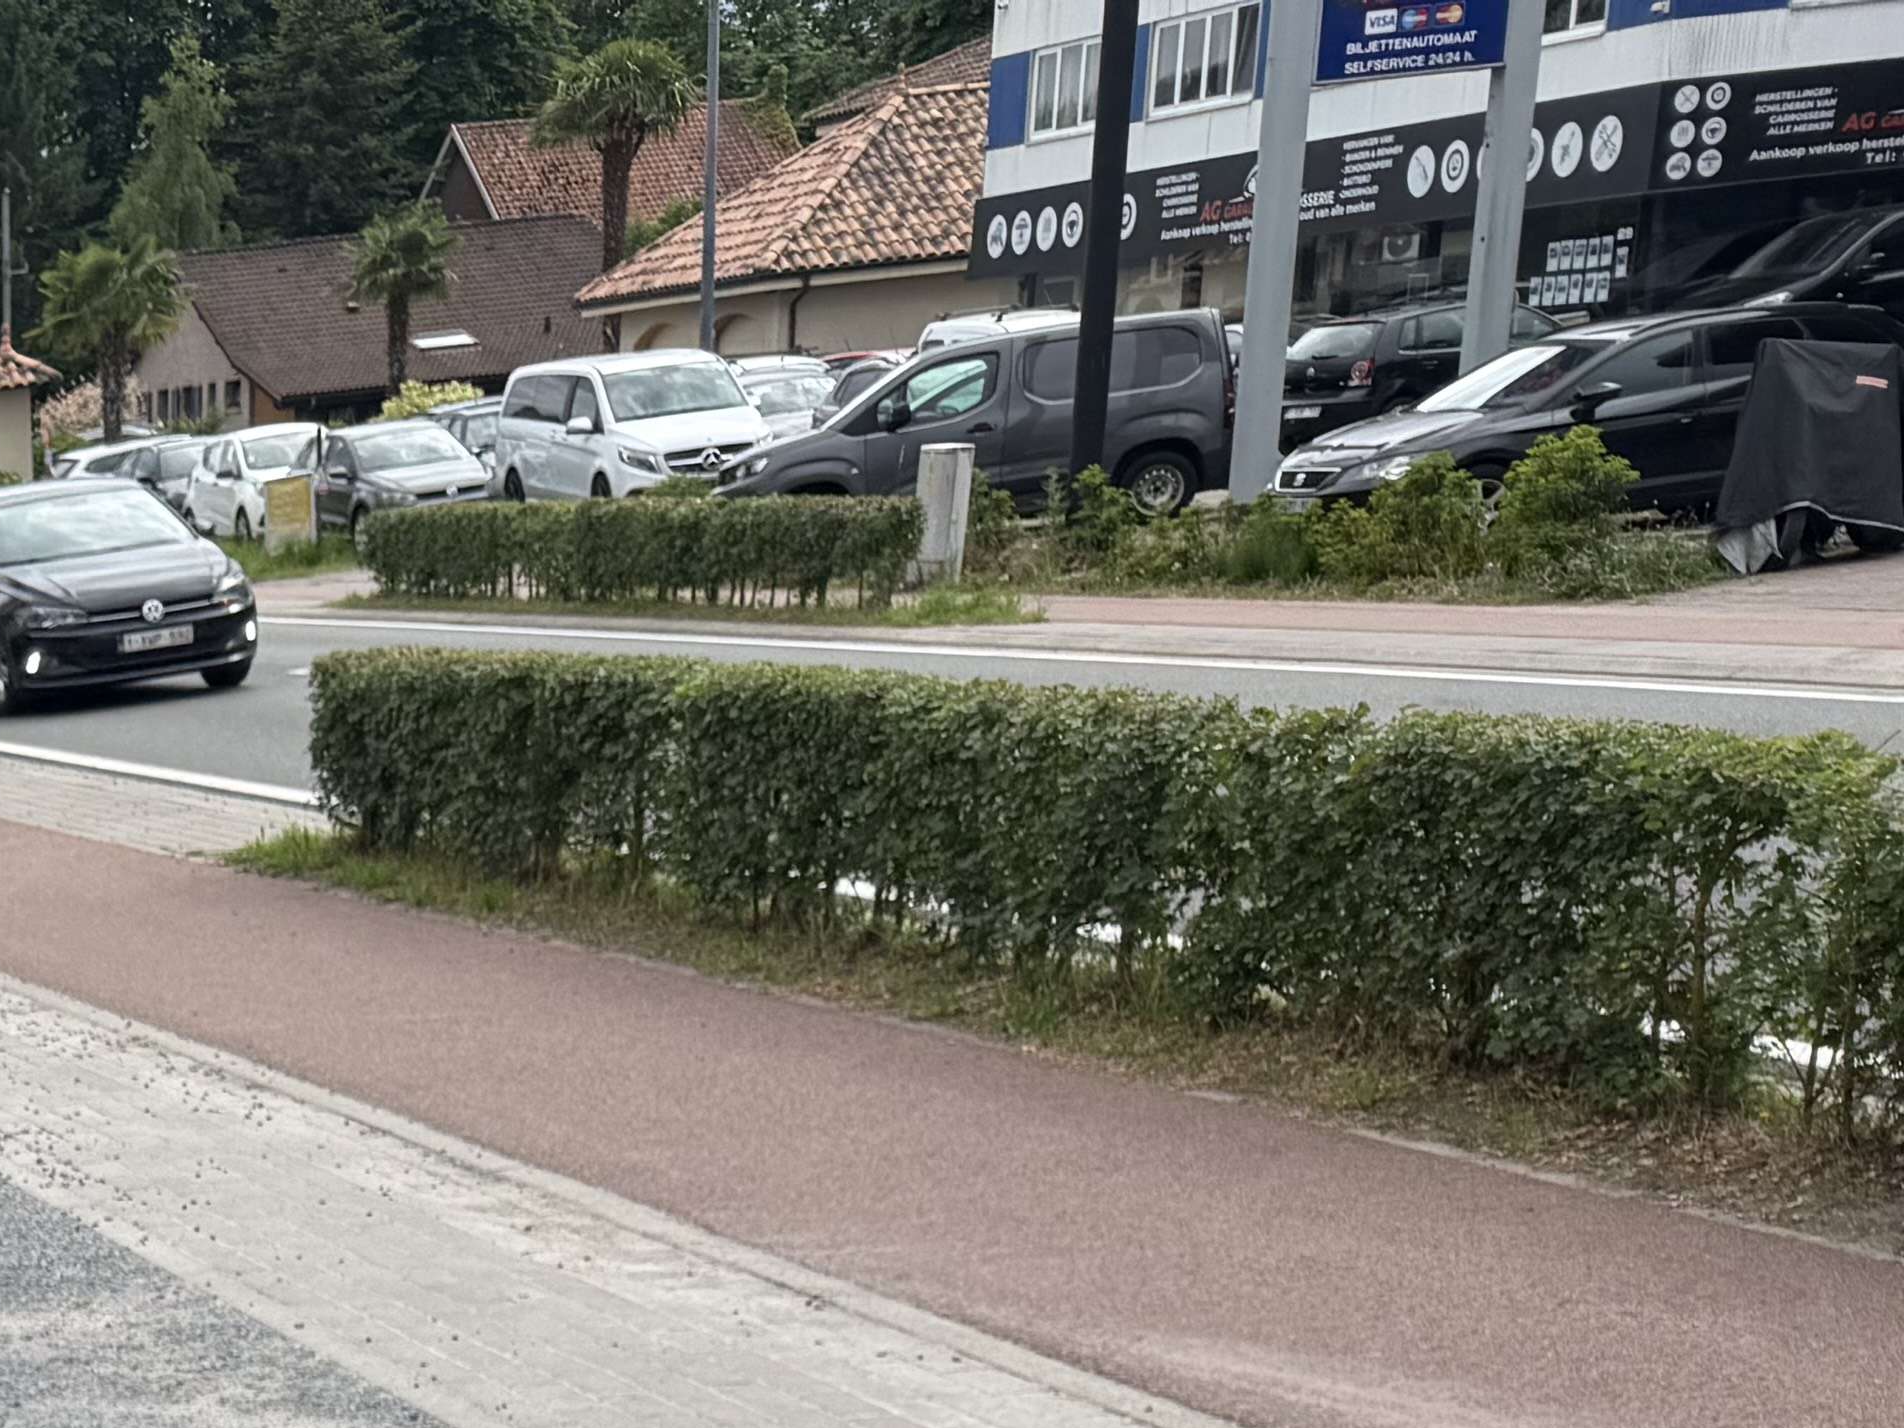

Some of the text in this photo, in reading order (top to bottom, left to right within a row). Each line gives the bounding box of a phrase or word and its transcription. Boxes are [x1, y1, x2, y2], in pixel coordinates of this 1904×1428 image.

[1345, 30, 1478, 56] BILJETTENAUTOMAAT
[1344, 54, 1425, 75] SELFSERVICE
[1749, 145, 1806, 162] Aankoop
[1808, 141, 1860, 154] verkoop
